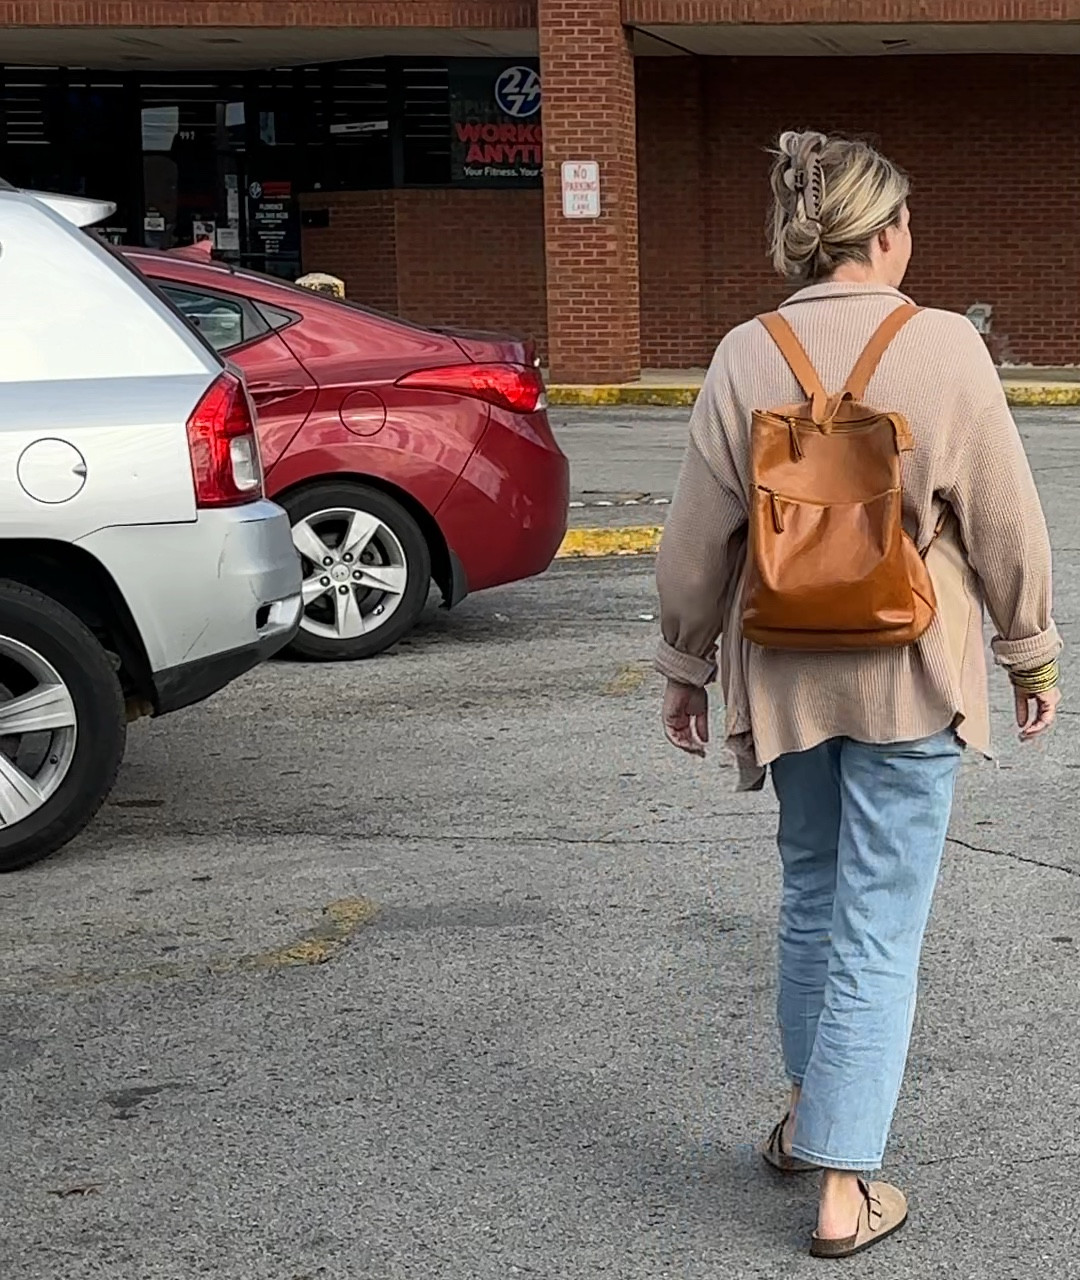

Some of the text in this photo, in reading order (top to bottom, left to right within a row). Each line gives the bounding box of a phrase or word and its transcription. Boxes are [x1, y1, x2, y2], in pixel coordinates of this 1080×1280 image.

[501, 67, 542, 101] 24
[507, 95, 526, 116] 7
[463, 166, 483, 176] Your
[519, 167, 539, 176] Your
[573, 168, 587, 179] NO
[565, 181, 597, 192] PARKING
